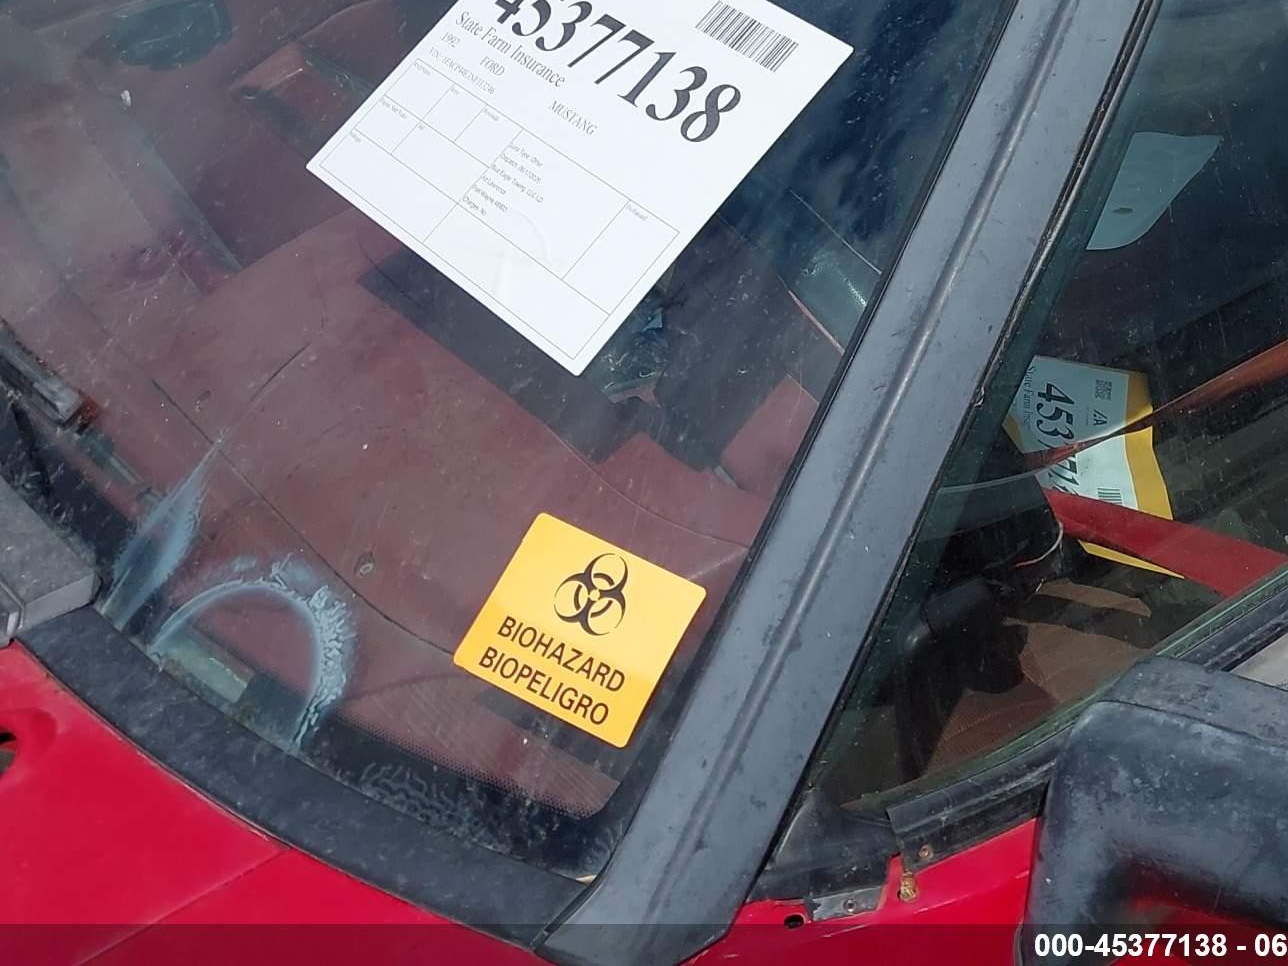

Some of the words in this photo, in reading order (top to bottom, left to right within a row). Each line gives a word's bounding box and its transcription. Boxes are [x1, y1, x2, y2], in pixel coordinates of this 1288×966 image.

[441, 31, 461, 49] 1992
[480, 55, 506, 76] FORD
[549, 100, 598, 135] MUSTANG
[456, 12, 484, 36] State
[481, 26, 512, 55] Farm
[510, 44, 566, 87] Insurance
[479, 647, 609, 726] BIOPELIGRO
[497, 616, 626, 692] BIOHAZARD
